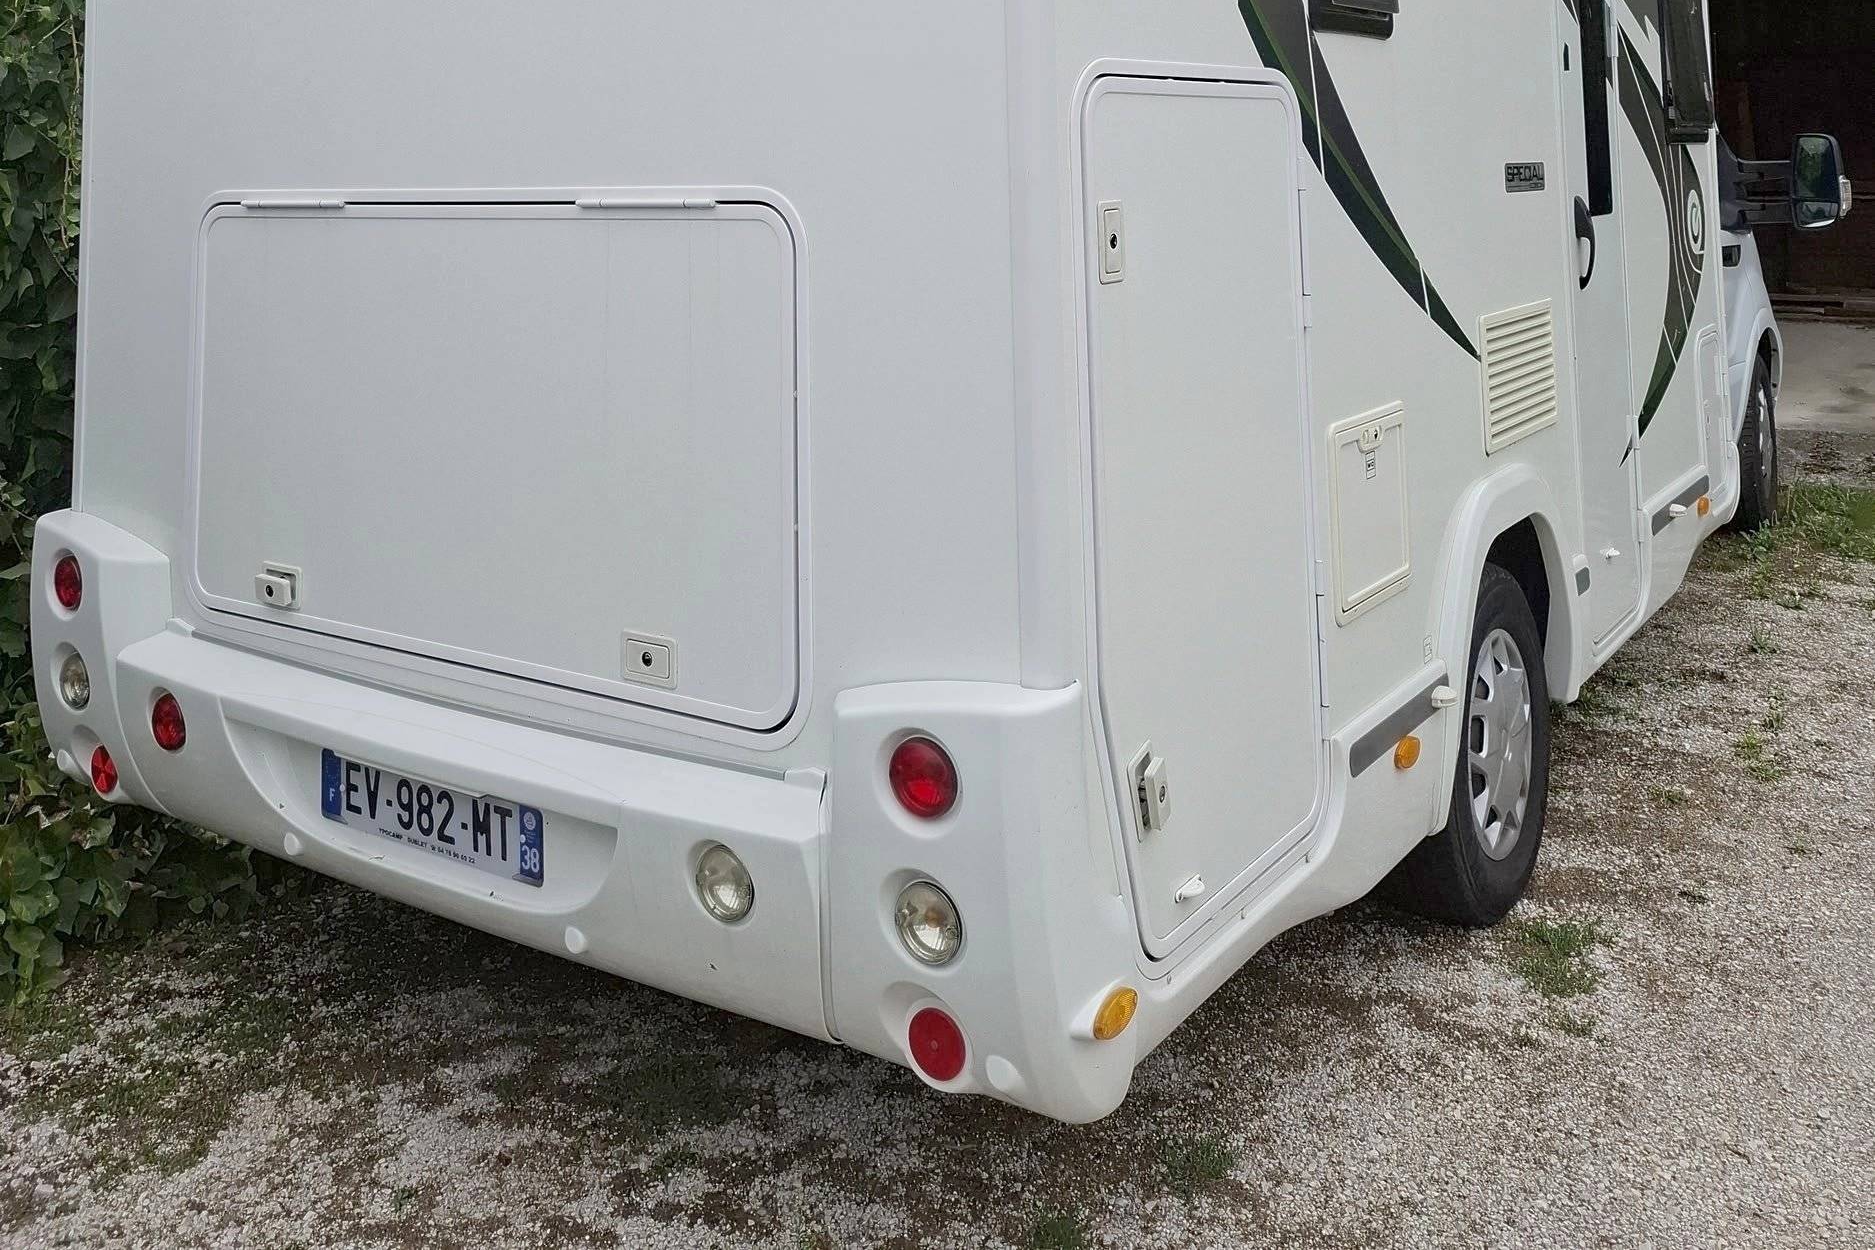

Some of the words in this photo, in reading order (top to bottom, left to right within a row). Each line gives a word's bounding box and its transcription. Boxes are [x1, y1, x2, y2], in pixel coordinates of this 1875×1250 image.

[329, 787, 336, 801] F
[345, 761, 513, 861] EV-982-MT
[521, 845, 540, 873] 38
